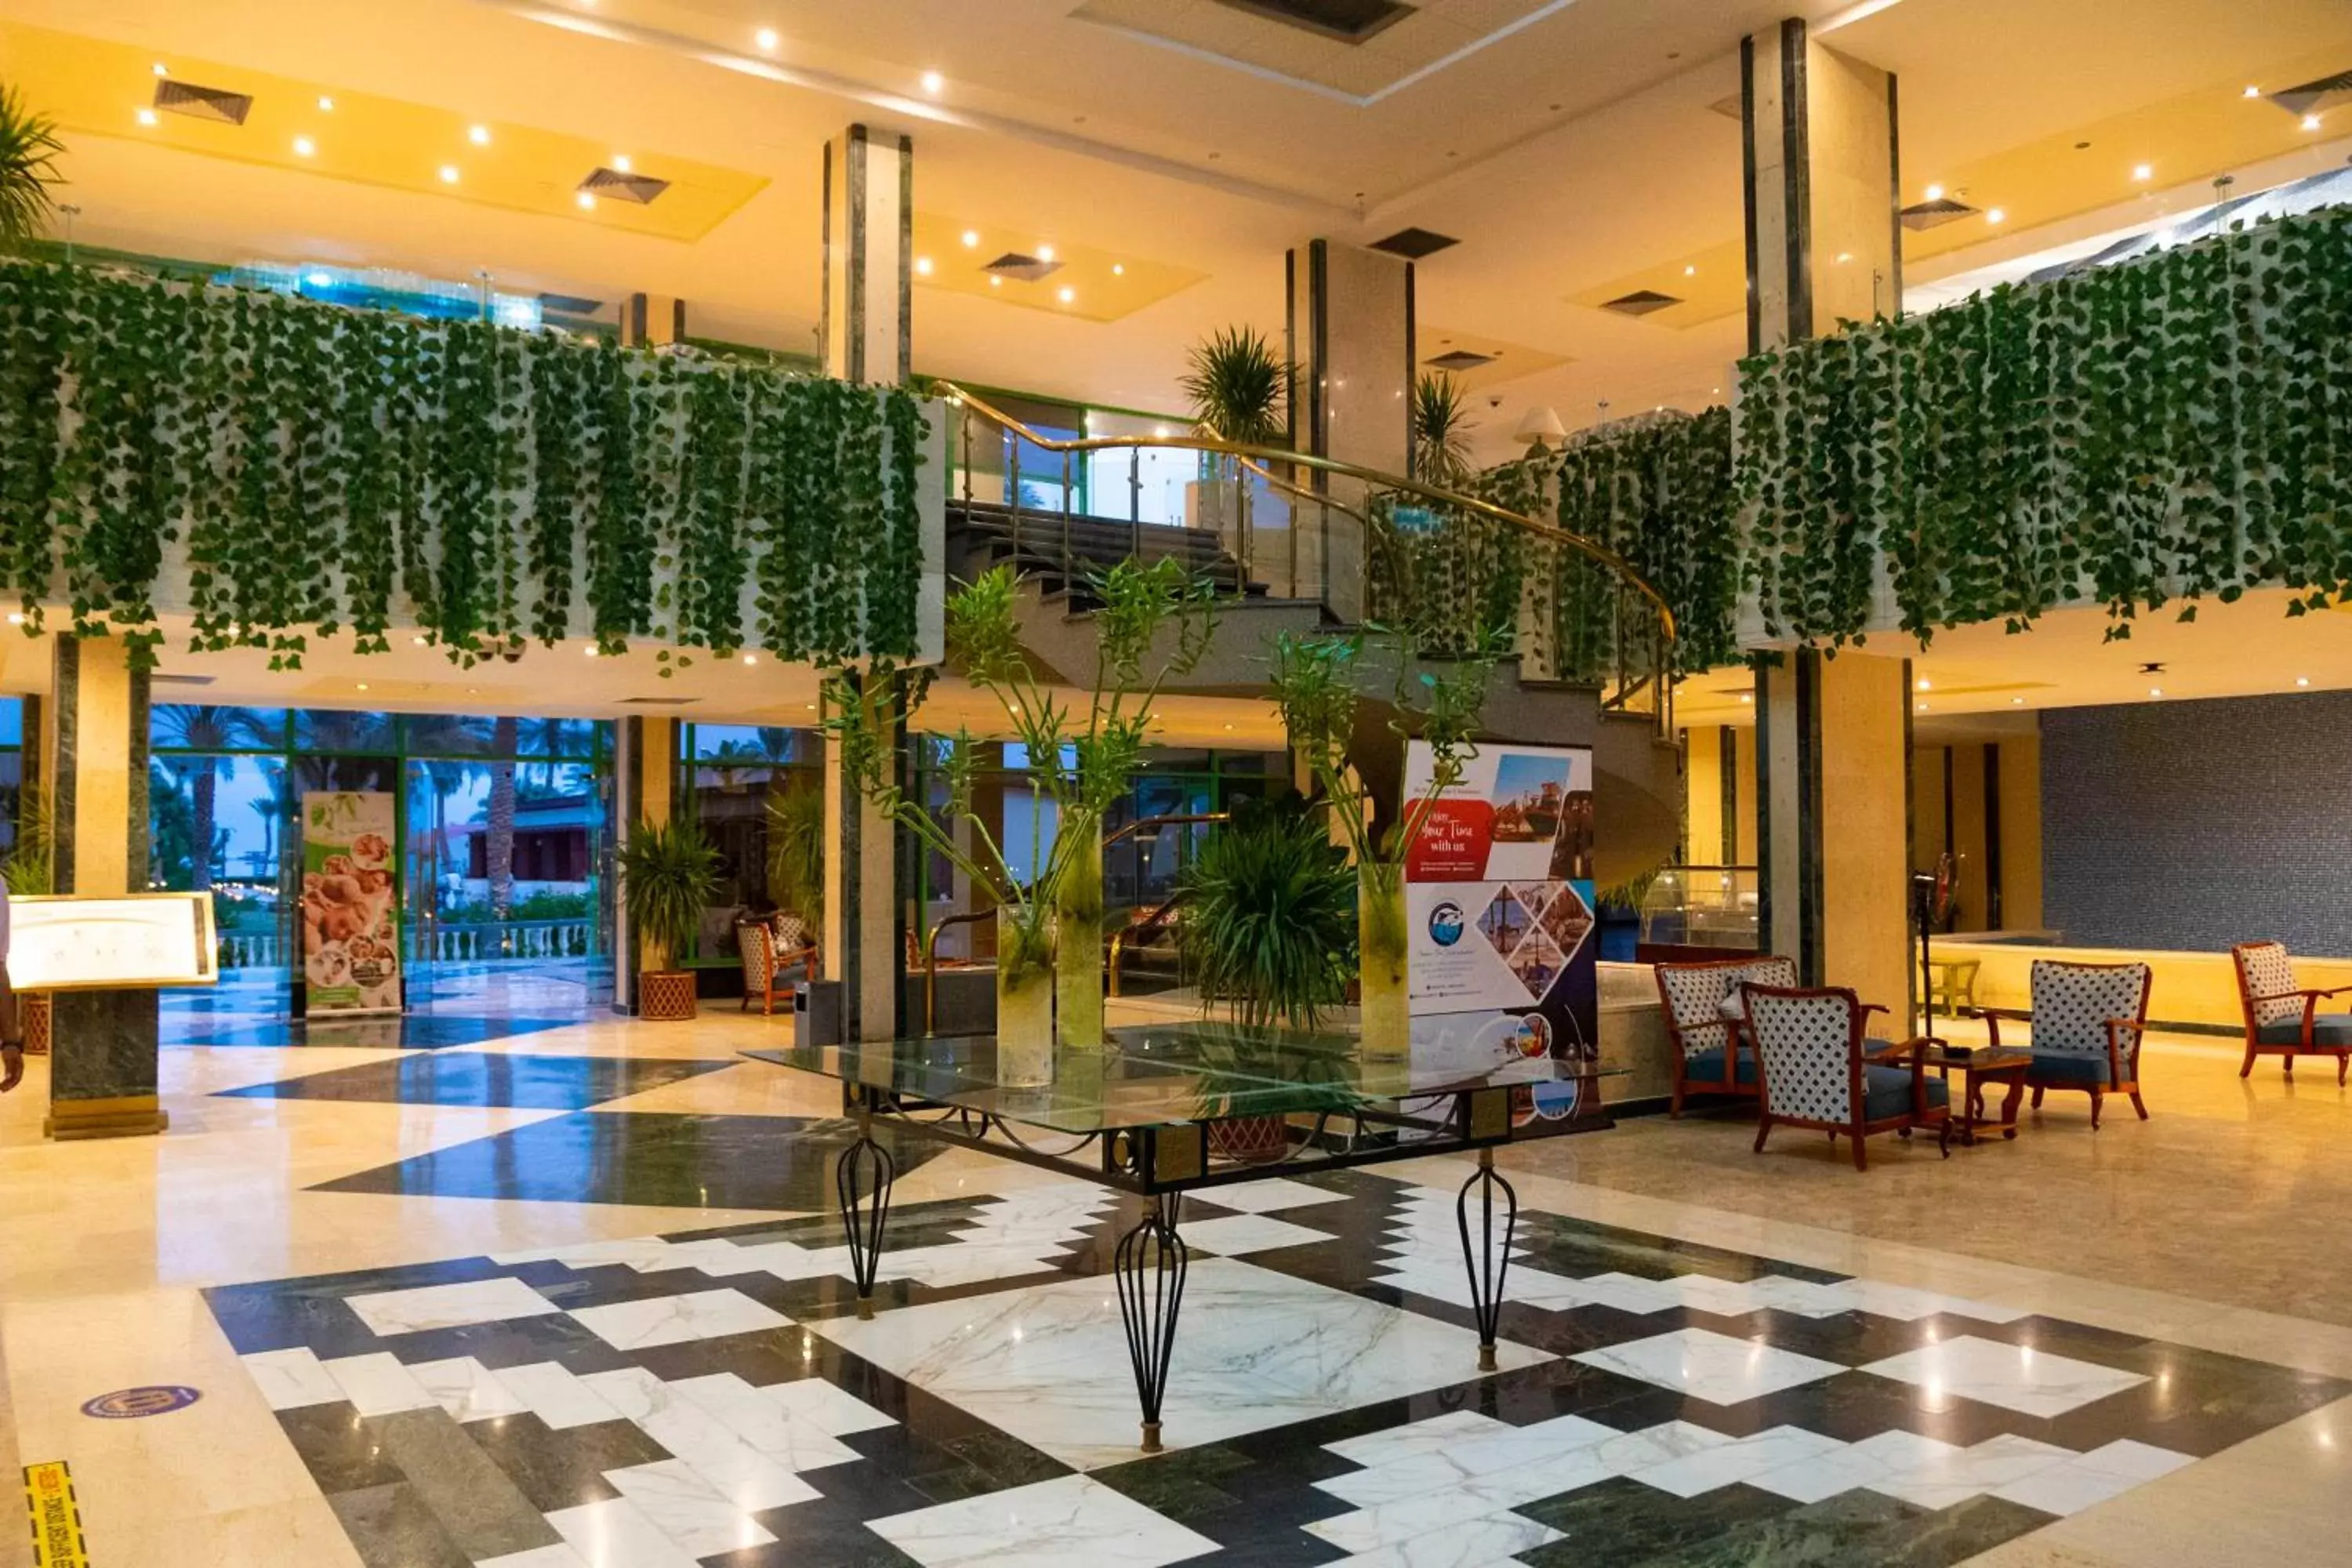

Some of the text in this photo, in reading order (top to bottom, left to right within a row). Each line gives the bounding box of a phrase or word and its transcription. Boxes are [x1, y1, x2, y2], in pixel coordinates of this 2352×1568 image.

[1449, 819, 1473, 839] Time
[1431, 840, 1465, 852] with us
